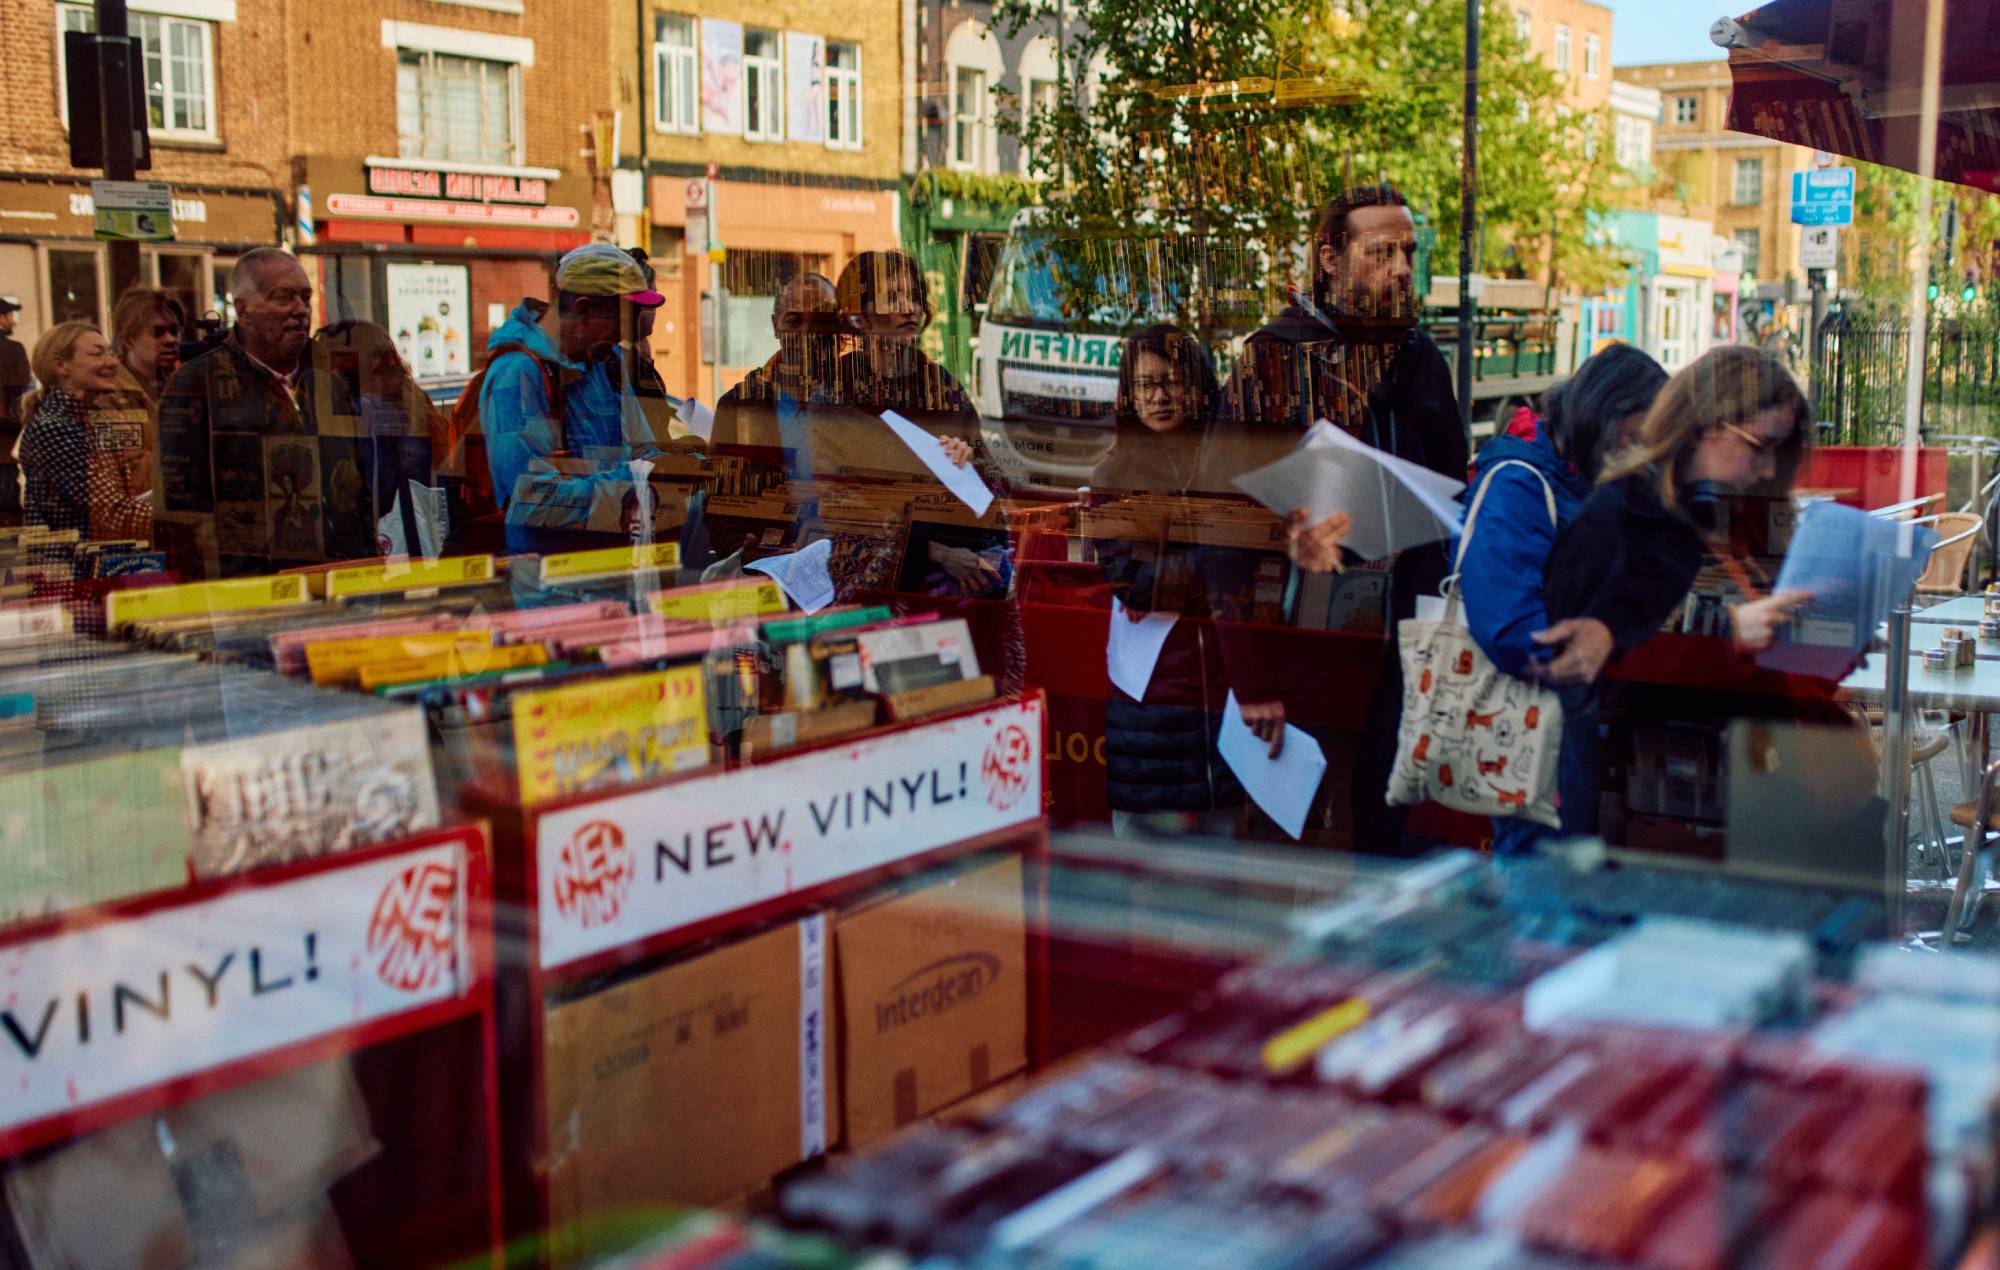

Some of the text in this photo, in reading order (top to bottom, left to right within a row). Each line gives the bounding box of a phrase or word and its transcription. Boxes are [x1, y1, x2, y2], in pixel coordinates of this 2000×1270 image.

[1014, 440, 1055, 452] MORE
[655, 758, 967, 882] NEW VINYL!
[0, 933, 321, 1058] VINYL!
[874, 964, 984, 1034] Interdean
